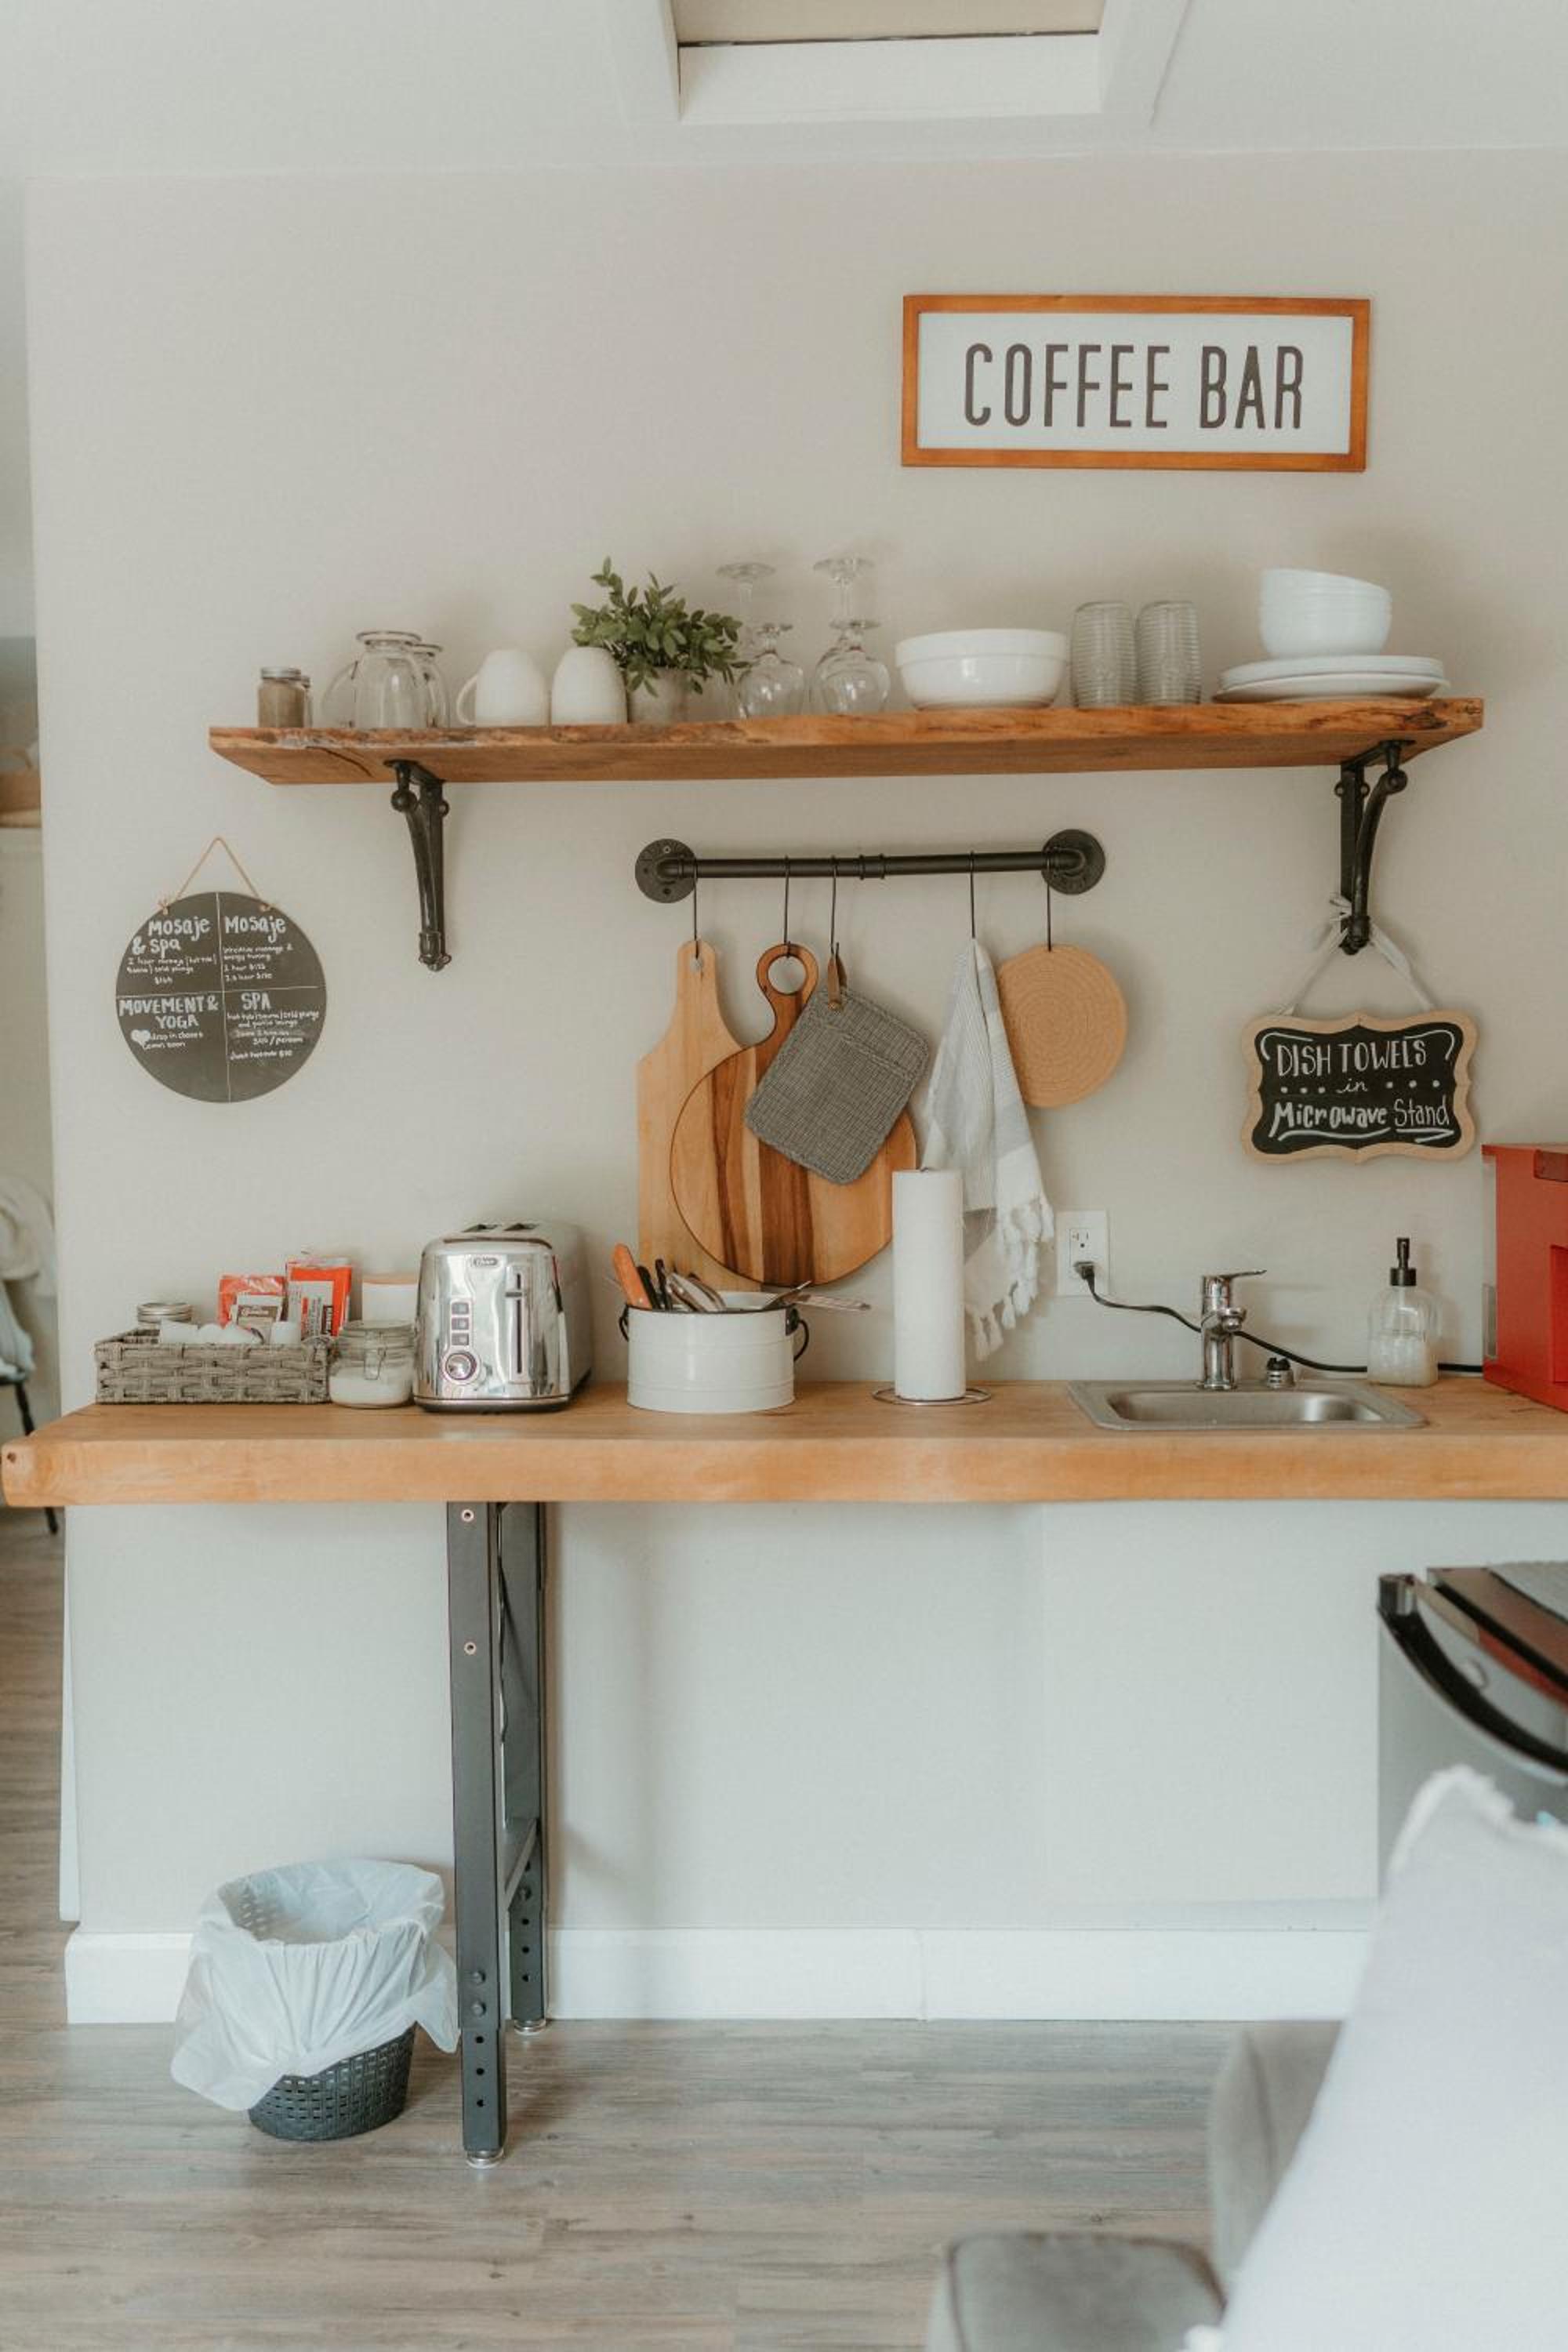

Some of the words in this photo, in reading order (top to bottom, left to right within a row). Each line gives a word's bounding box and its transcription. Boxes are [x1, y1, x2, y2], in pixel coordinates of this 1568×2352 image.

[964, 343, 1170, 428] COFFEE
[1200, 345, 1303, 429] BAR
[225, 916, 286, 943] Mosaje
[132, 936, 147, 955] &
[119, 996, 205, 1017] MOVEMENT
[207, 995, 219, 1011] &
[241, 993, 271, 1011] SPA
[155, 1014, 199, 1029] YOGA
[1276, 1044, 1331, 1076] DISH
[1338, 1040, 1427, 1073] TOWELS
[1336, 1078, 1368, 1094] in
[1269, 1101, 1388, 1138] Microwave
[1393, 1094, 1450, 1127] Stand
